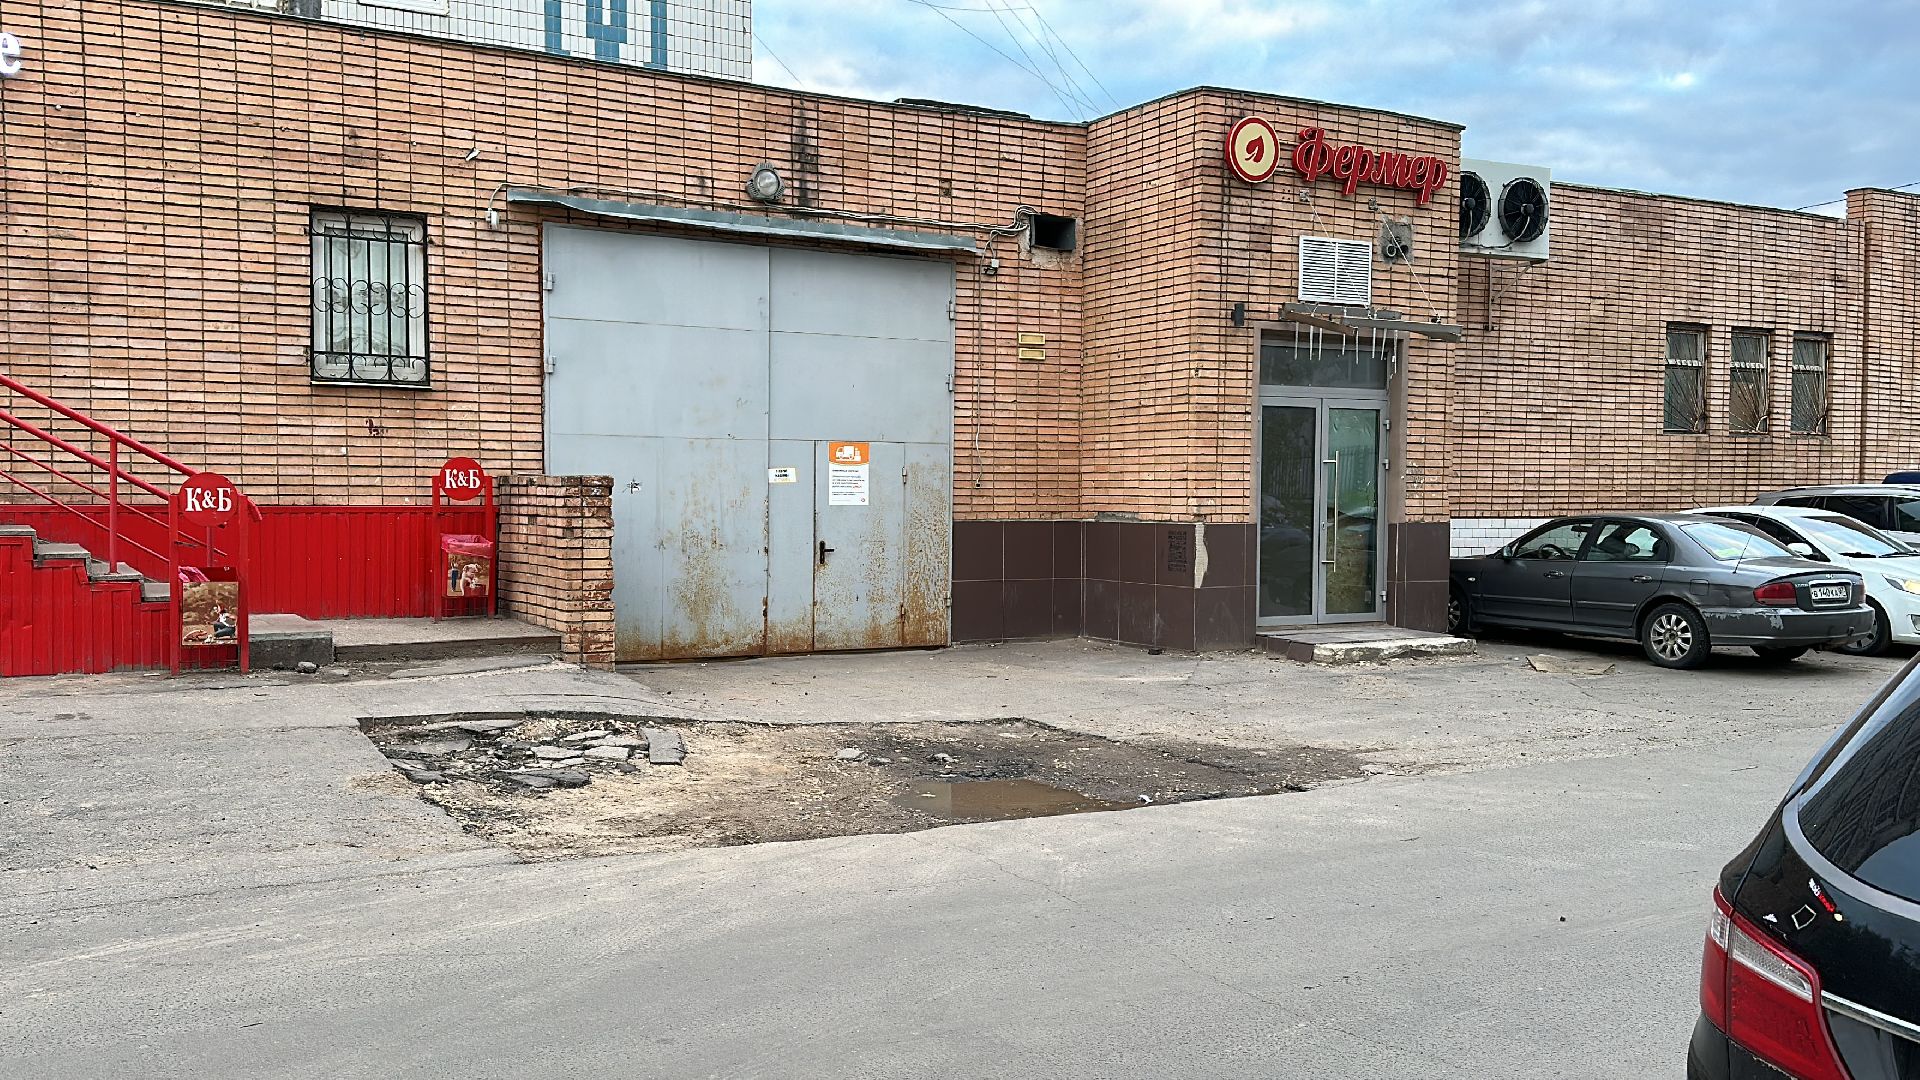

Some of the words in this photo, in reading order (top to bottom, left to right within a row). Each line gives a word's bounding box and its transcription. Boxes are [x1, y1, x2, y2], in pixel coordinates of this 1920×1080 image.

[1292, 127, 1448, 205] Фермер
[444, 469, 480, 489] К&Б
[184, 487, 232, 512] К&Б
